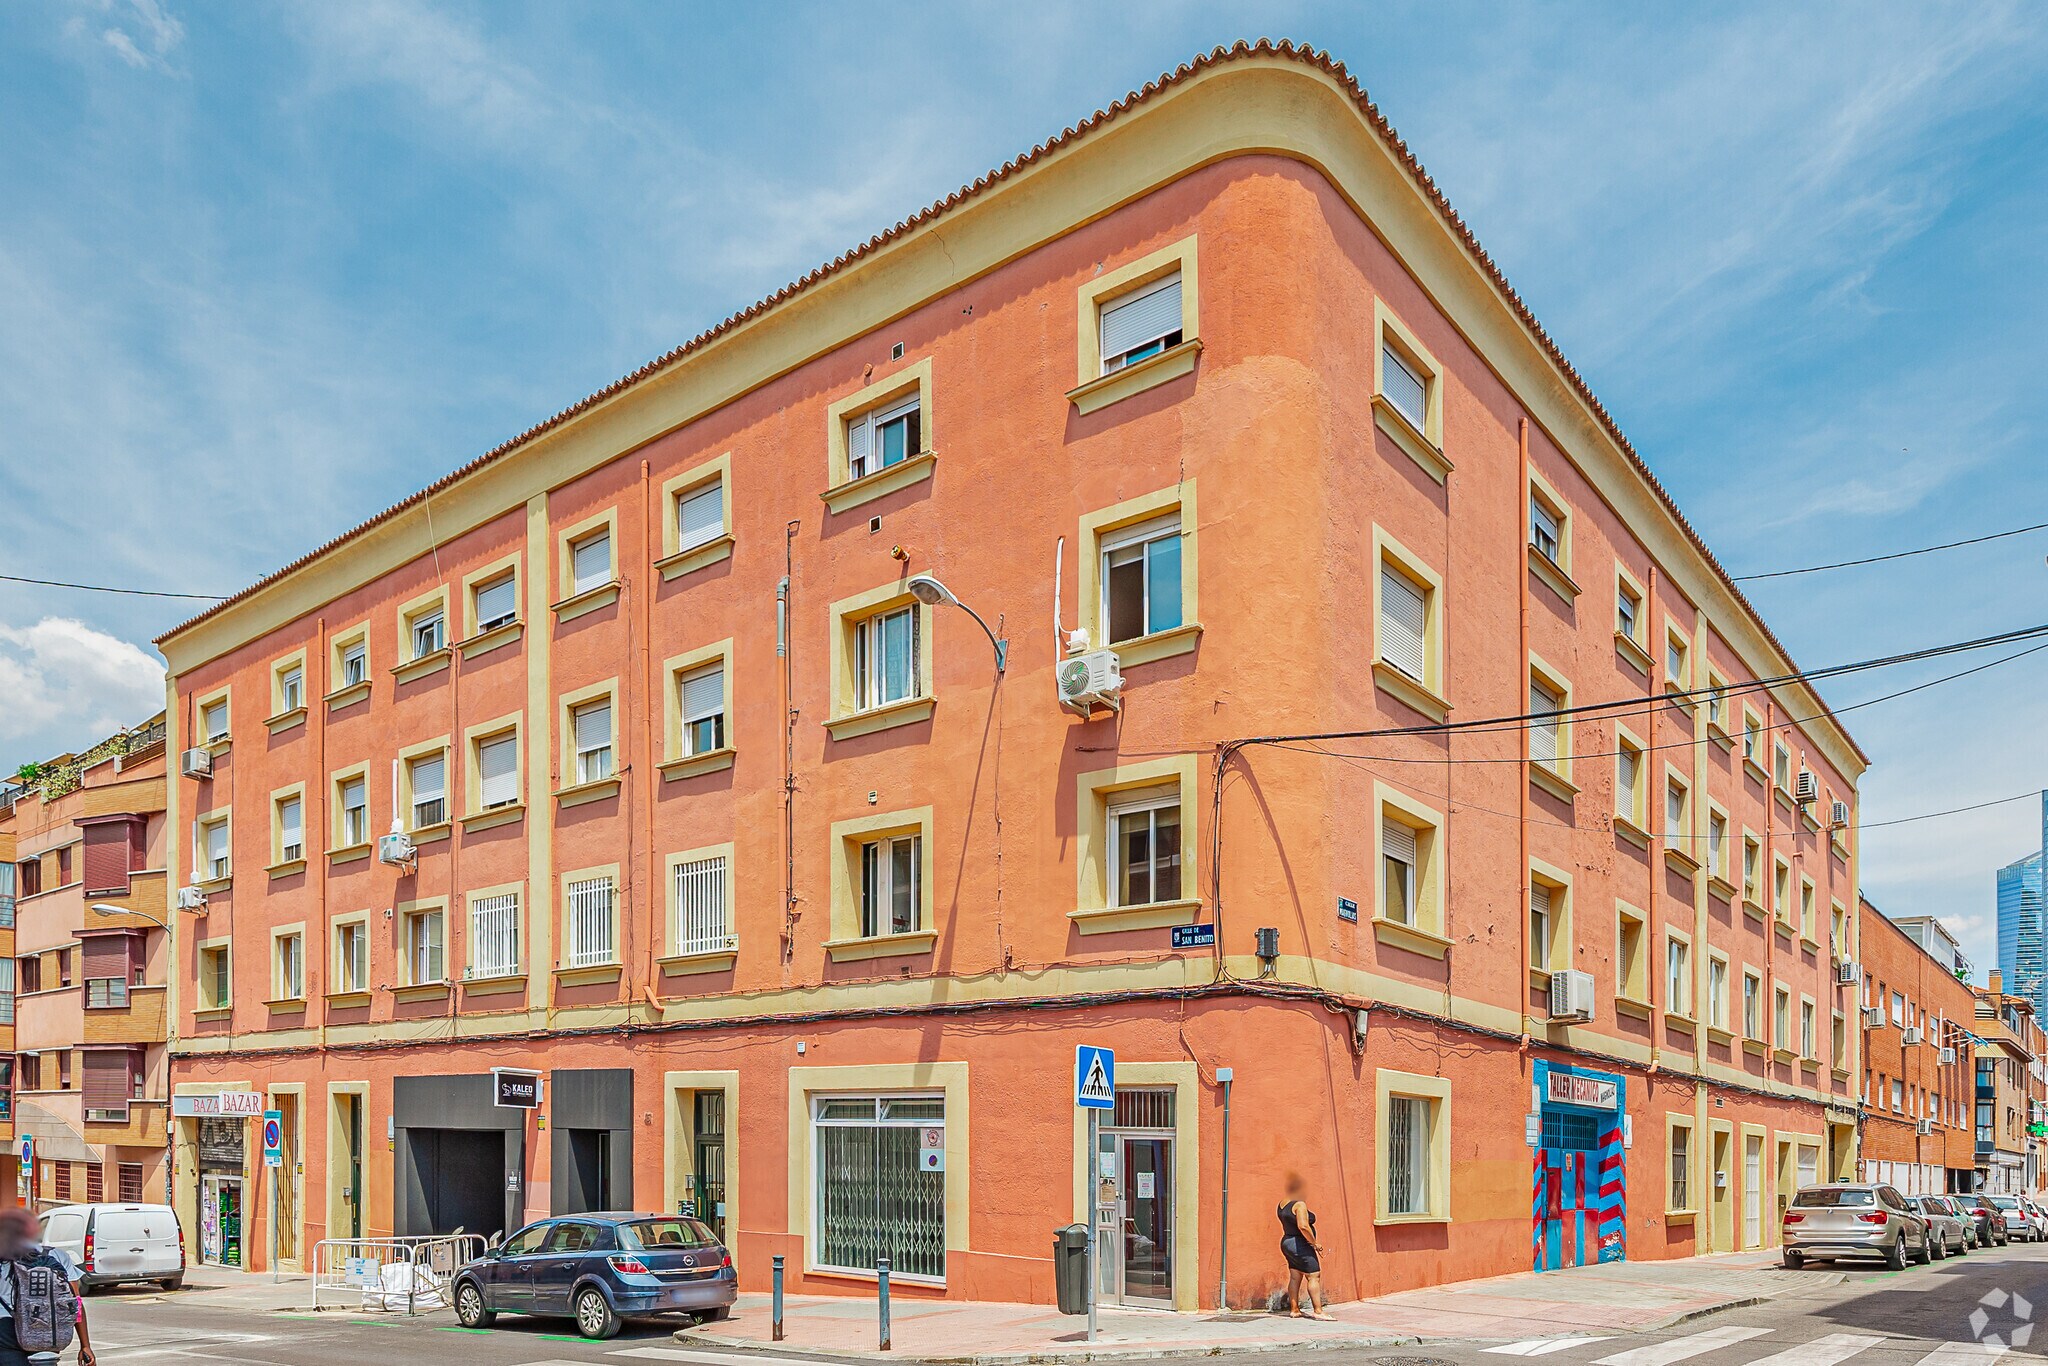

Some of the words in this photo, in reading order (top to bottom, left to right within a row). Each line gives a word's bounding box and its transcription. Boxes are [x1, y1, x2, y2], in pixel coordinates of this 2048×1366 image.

[1193, 926, 1200, 934] DE
[1181, 936, 1193, 945] SAN
[1194, 934, 1214, 944] BENITO
[512, 1083, 533, 1093] KALEO
[1549, 1073, 1571, 1101] TALLER
[193, 1098, 220, 1113] BAZA
[223, 1093, 260, 1113] BAZAR
